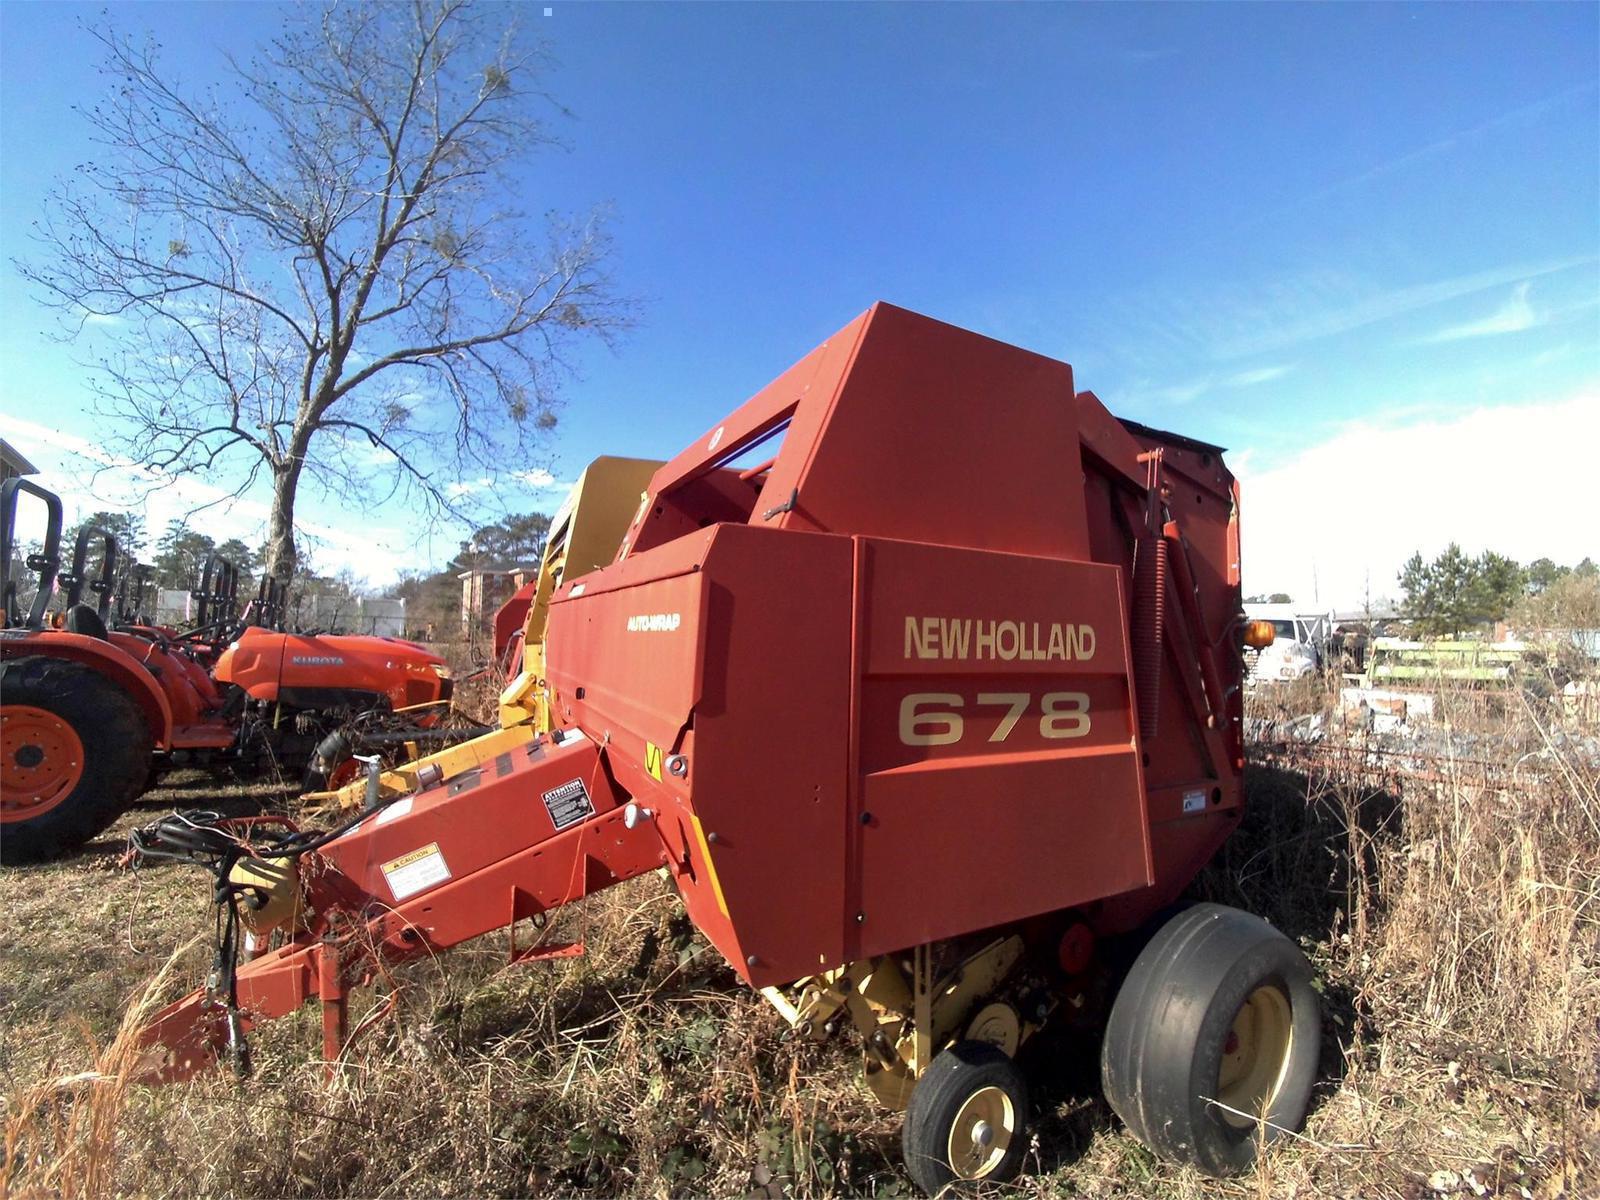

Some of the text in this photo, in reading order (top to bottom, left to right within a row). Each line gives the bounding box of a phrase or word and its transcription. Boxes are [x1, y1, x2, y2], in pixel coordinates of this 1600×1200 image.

[904, 616, 1096, 661] NEW HOLLAND
[293, 656, 344, 665] KUBOTA
[899, 692, 1091, 746] 678
[544, 780, 582, 802] ATTENTION
[400, 850, 428, 865] CAUTION
